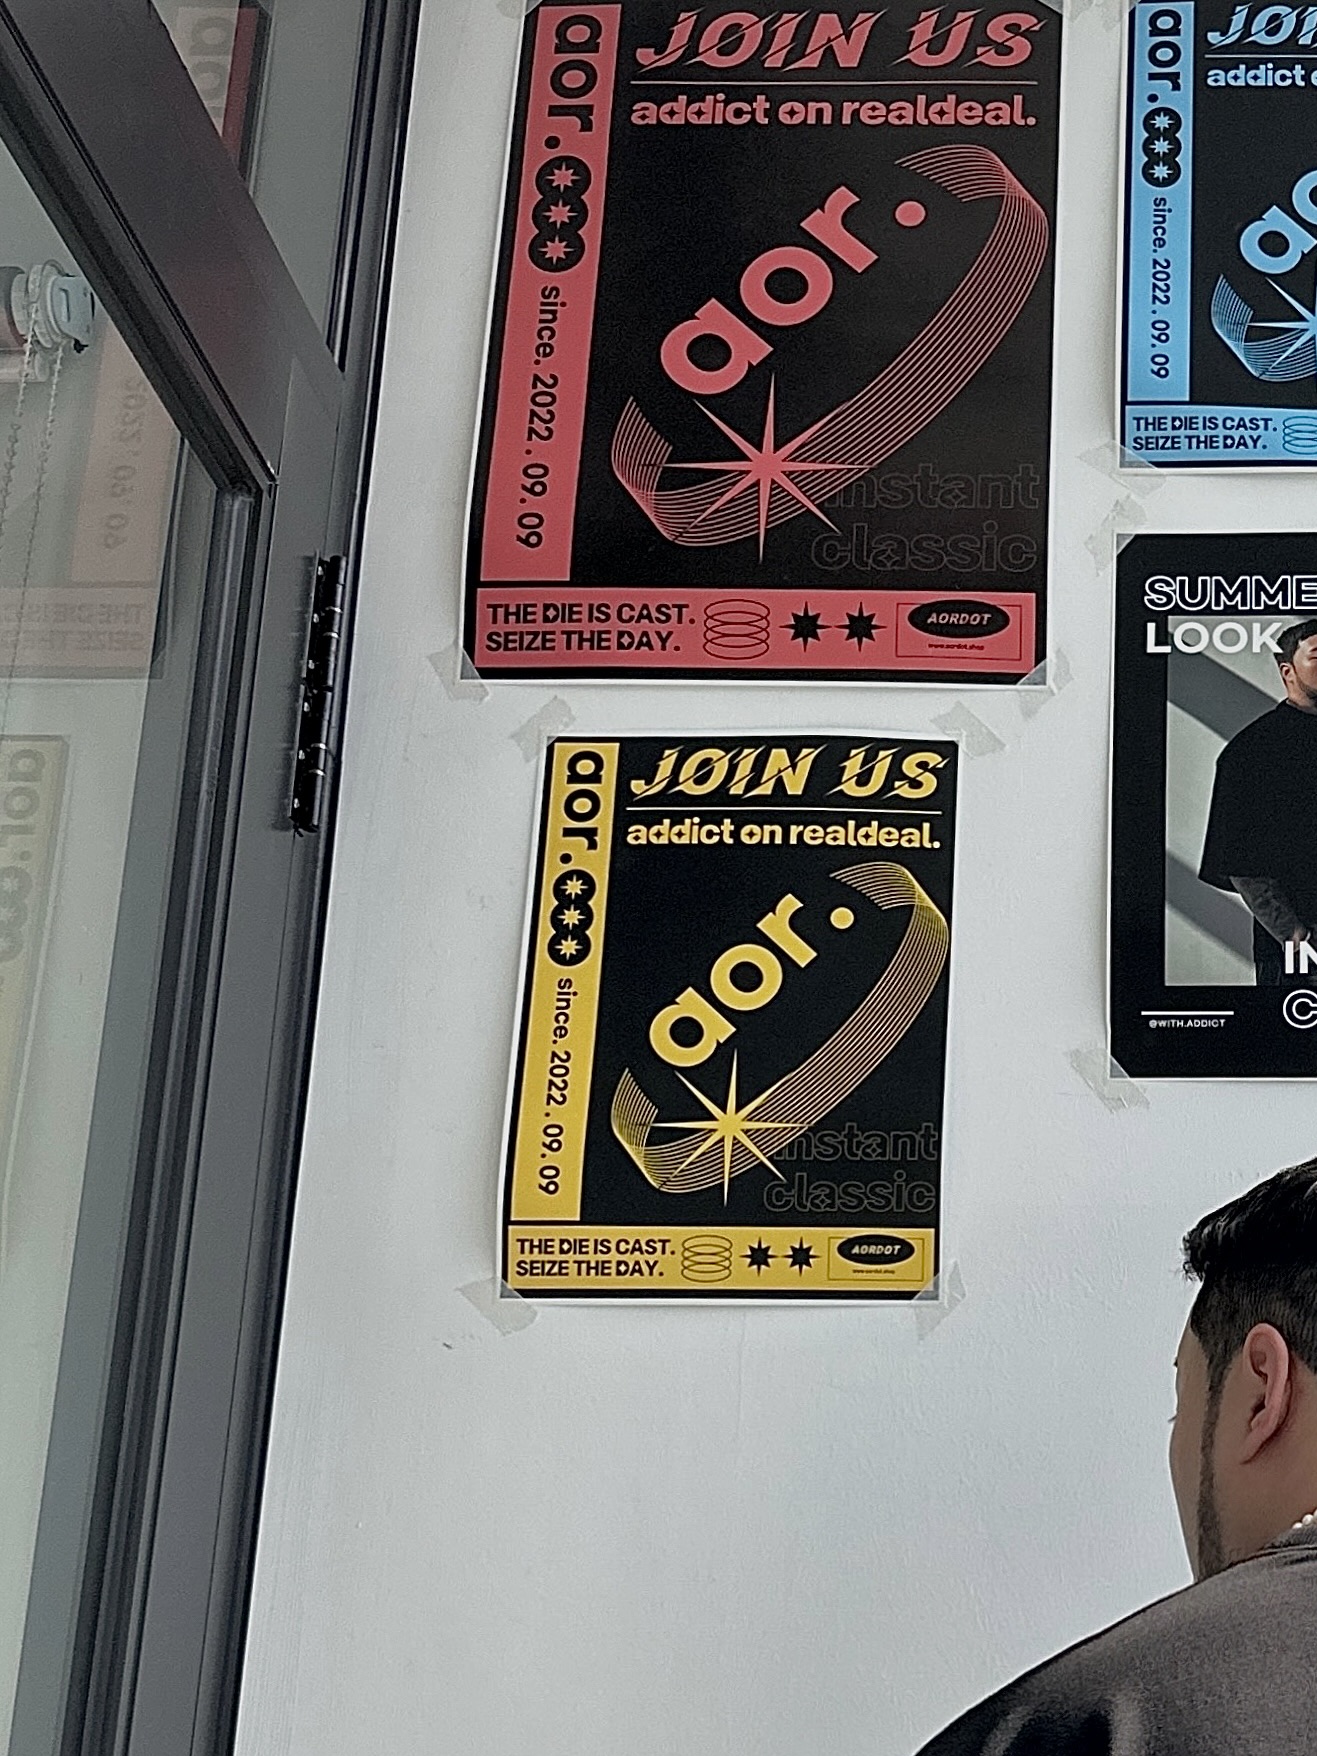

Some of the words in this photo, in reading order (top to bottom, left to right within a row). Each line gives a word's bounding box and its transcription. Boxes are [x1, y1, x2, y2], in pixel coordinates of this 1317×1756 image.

[636, 9, 884, 71] JOIN
[902, 7, 1047, 70] US
[1146, 9, 1182, 103] aor.
[542, 14, 603, 150] aor.
[1206, 64, 1305, 88] addict
[631, 93, 769, 125] addict
[779, 101, 832, 125] on
[842, 94, 1037, 126] realdeal.
[1152, 197, 1172, 254] since.
[660, 185, 927, 395] aor.
[533, 285, 566, 366] since.
[1133, 416, 1167, 432] THE
[1171, 417, 1199, 431] DIE
[1202, 417, 1219, 432] IS
[1222, 417, 1277, 432] CAST.
[1133, 435, 1181, 451] SEIZE
[1186, 435, 1220, 450] THE
[1223, 435, 1267, 450] DAY.
[825, 463, 1039, 509] nstant
[811, 520, 1038, 572] classic
[487, 603, 536, 624] THE
[542, 603, 583, 624] DIE
[588, 604, 613, 624] IS
[618, 603, 696, 625] CAST.
[927, 612, 992, 626] AORDOT
[486, 631, 556, 652] SEIZE
[561, 631, 611, 651] THE
[617, 630, 681, 652] DAY.
[1146, 622, 1283, 654] LOOK
[631, 747, 828, 798] JOIN
[838, 748, 949, 799] US
[559, 750, 603, 865] aor.
[627, 817, 734, 845] addict
[741, 825, 783, 845] on
[789, 819, 941, 849] realdeal.
[649, 893, 854, 1067] aor.
[551, 978, 577, 1046] since.
[774, 1122, 938, 1161] nstant
[763, 1170, 936, 1212] classic
[516, 1238, 555, 1255] THE
[559, 1238, 590, 1255] DIE
[594, 1238, 612, 1256] IS
[616, 1238, 675, 1256] CAST.
[851, 1244, 901, 1255] AORDOT
[516, 1260, 570, 1277] SEIZE
[575, 1260, 612, 1277] THE
[616, 1260, 664, 1277] DAY.
